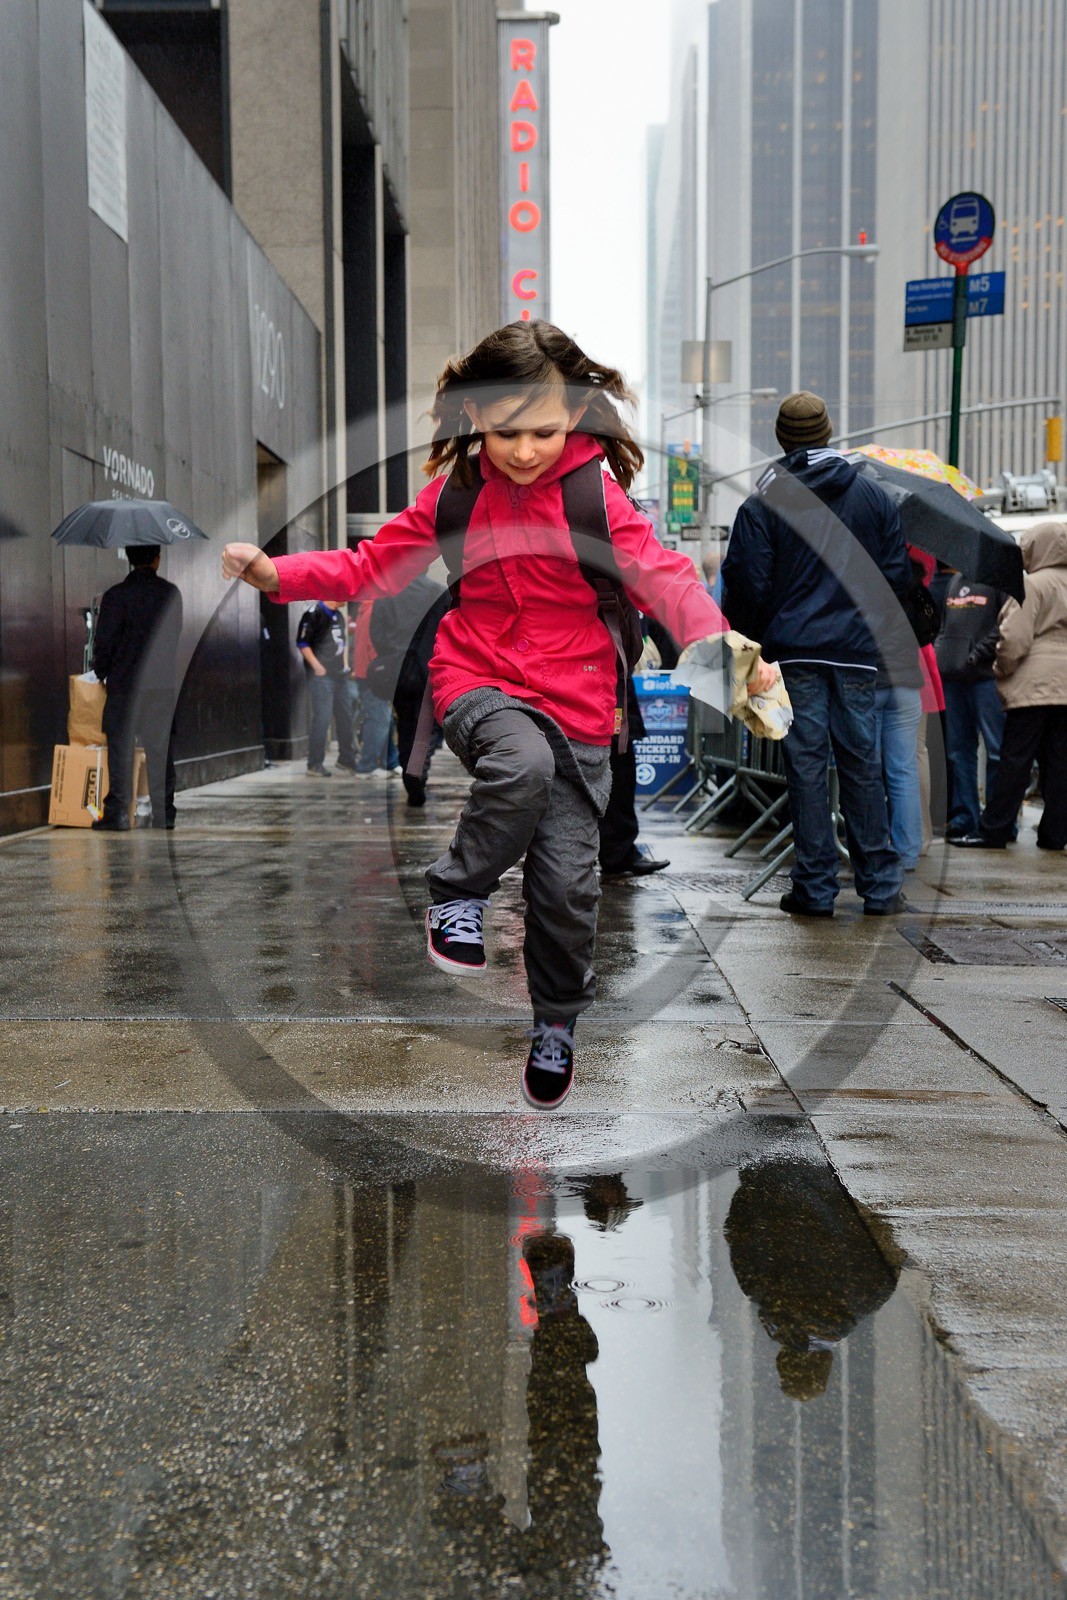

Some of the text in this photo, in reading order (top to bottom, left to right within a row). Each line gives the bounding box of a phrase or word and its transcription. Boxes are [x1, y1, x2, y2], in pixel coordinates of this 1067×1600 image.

[508, 38, 542, 233] RADIO
[969, 275, 990, 293] M5
[969, 297, 989, 314] M7
[102, 445, 155, 498] VORNADO
[633, 735, 684, 745] ANDARD
[636, 745, 679, 754] TICKETS
